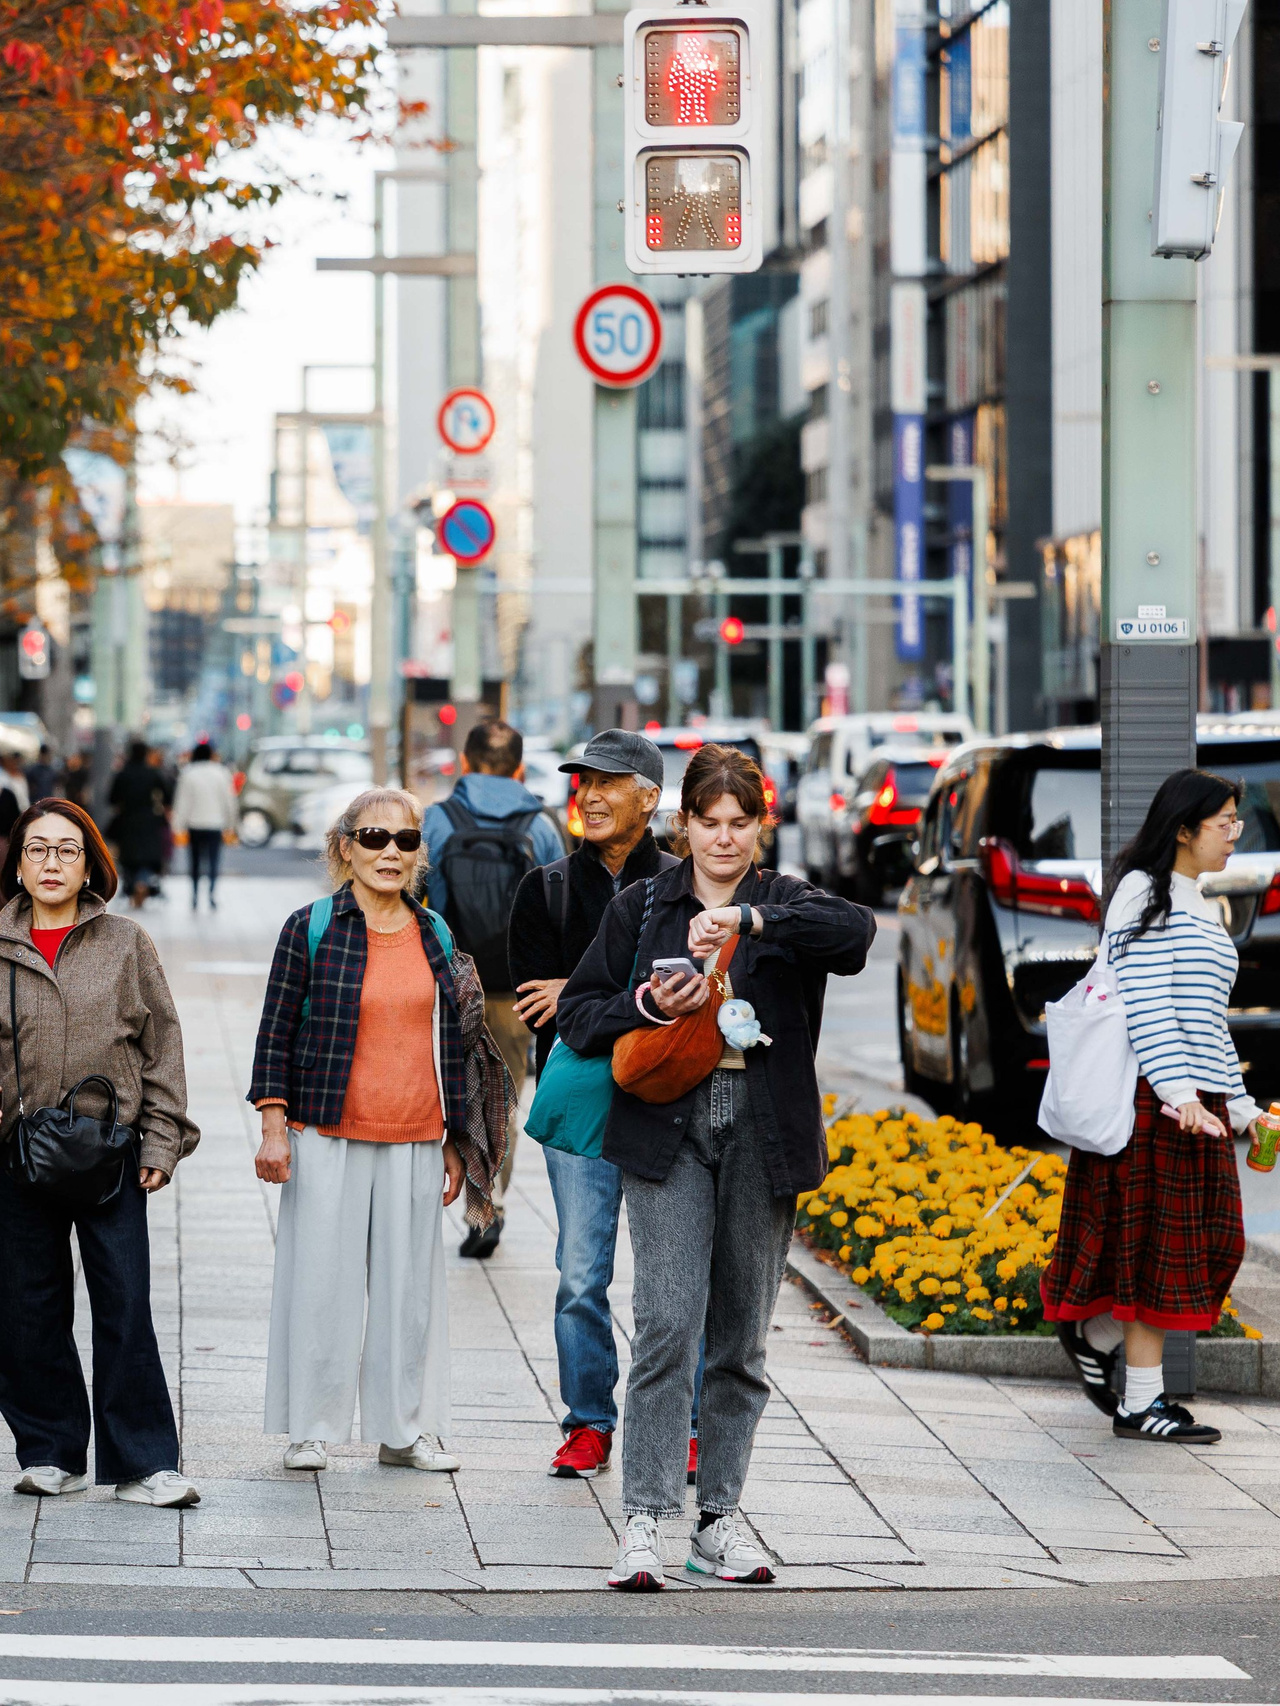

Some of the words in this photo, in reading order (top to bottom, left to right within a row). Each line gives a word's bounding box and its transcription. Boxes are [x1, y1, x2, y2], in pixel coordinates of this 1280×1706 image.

[593, 312, 643, 355] 50
[1138, 623, 1146, 633] U
[1150, 623, 1178, 633] 0106
